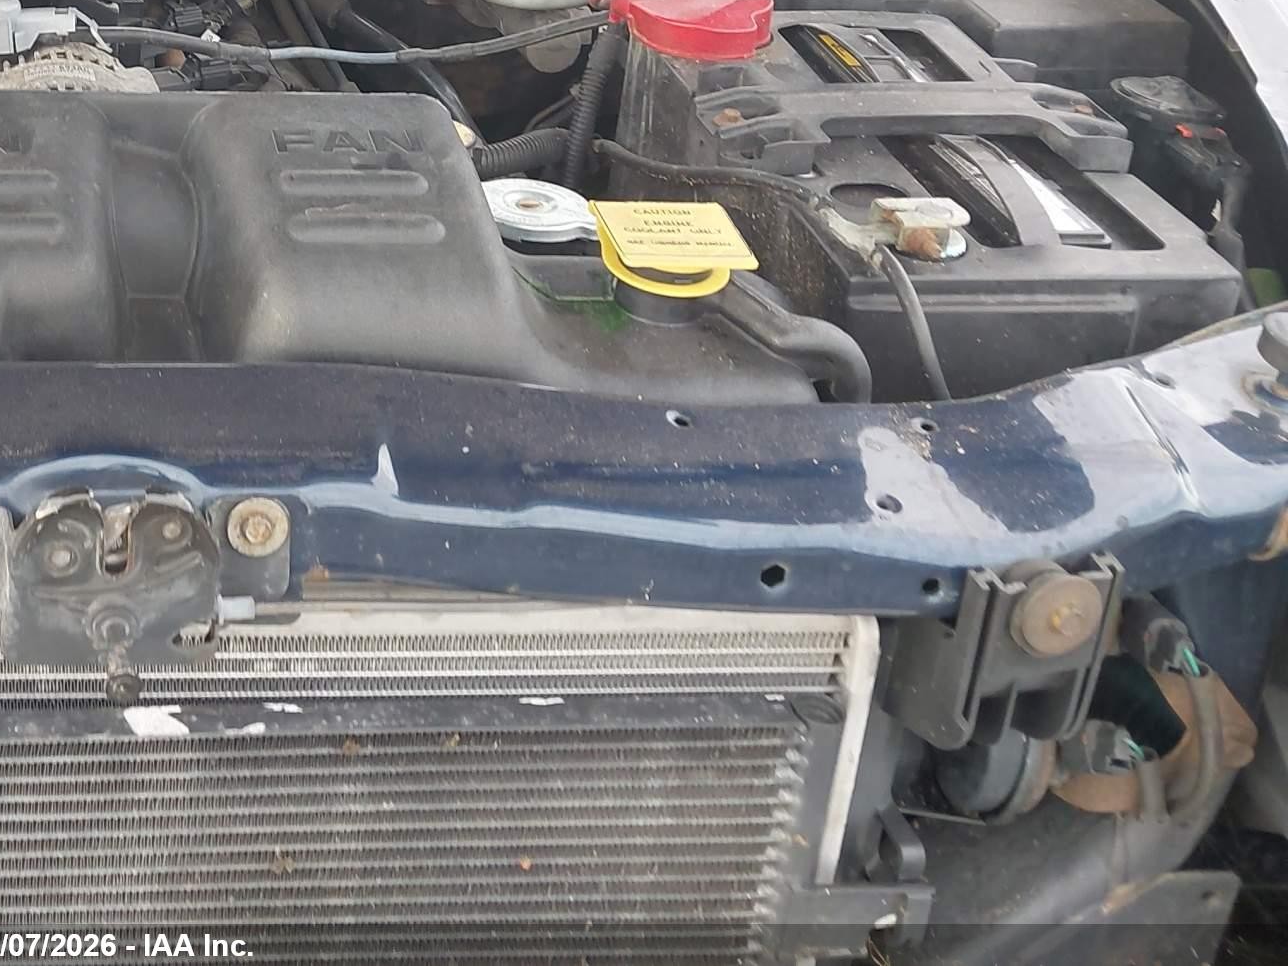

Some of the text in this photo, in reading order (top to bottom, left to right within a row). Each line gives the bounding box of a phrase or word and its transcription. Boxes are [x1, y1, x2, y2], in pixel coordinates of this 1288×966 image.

[271, 129, 424, 154] FAN
[633, 208, 692, 216] CAUTION
[643, 219, 695, 227] ENGINE
